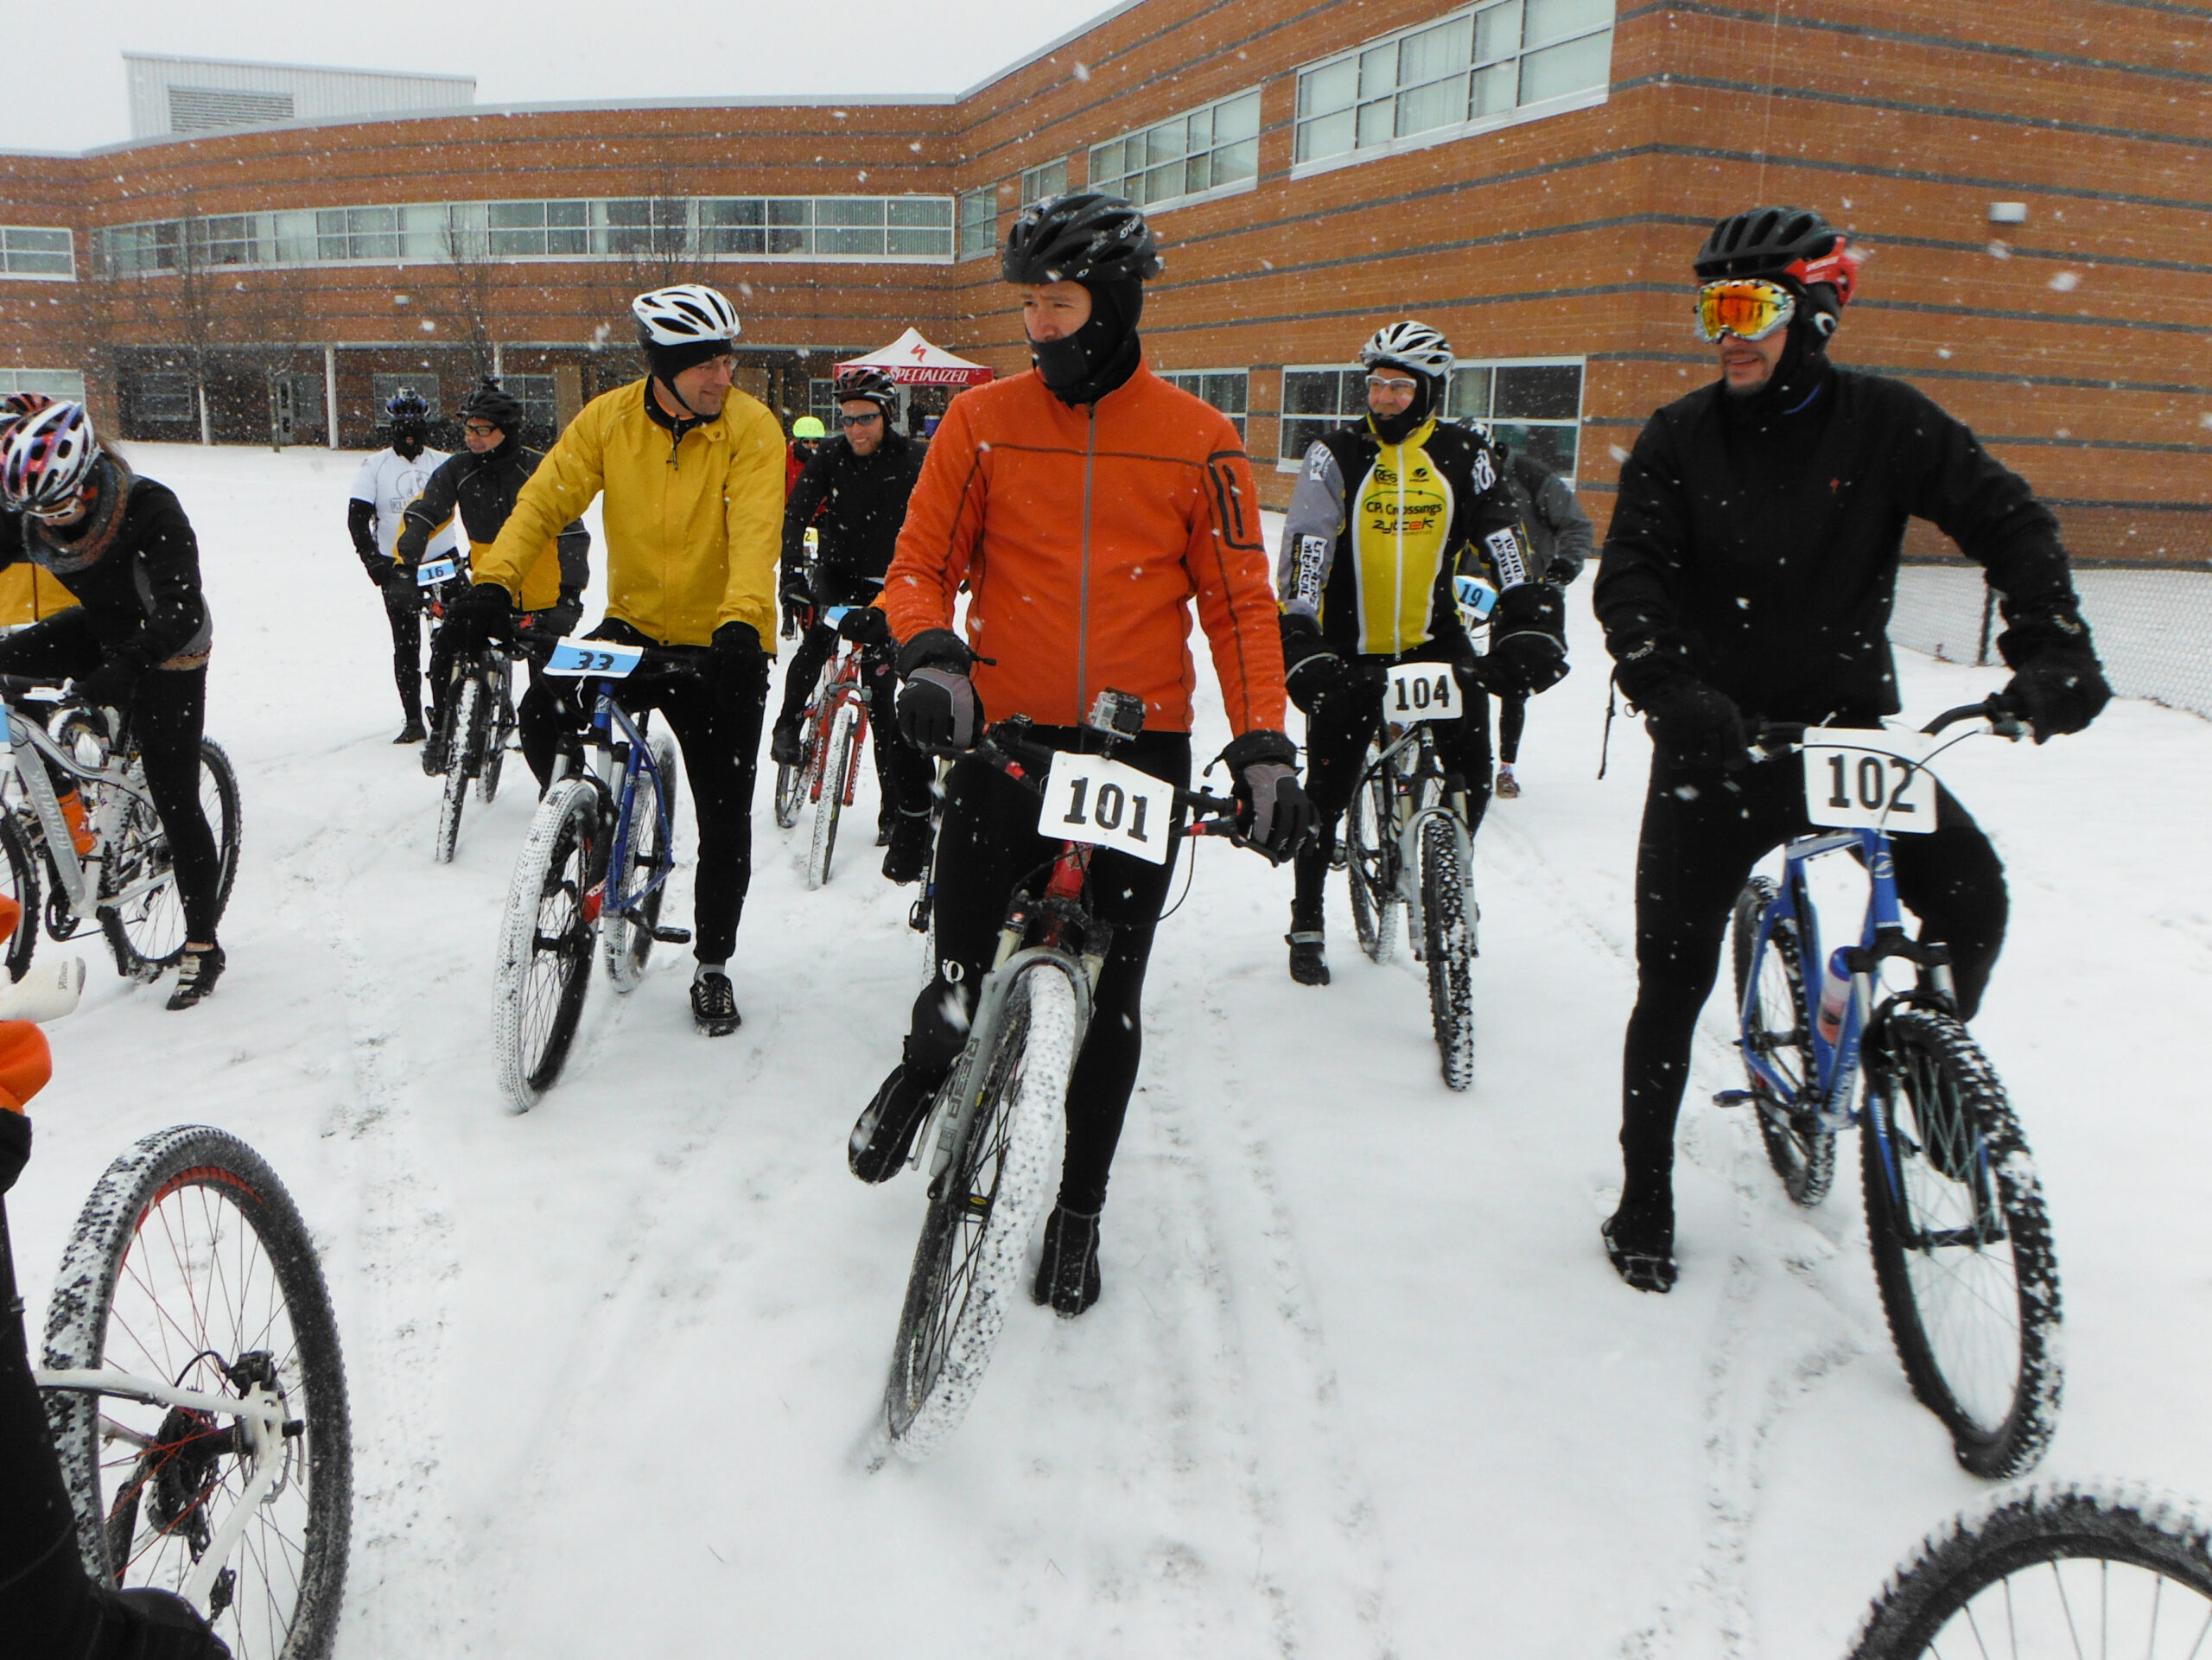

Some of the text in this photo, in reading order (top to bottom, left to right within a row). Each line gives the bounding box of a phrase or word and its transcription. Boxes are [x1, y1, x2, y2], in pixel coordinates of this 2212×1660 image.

[889, 368, 969, 383] SPECIALIZED
[426, 565, 445, 581] 16
[1459, 584, 1484, 608] 19
[570, 651, 615, 671] 33
[1395, 675, 1451, 711] 104
[1827, 754, 1916, 813] 102
[1064, 777, 1148, 843] 101
